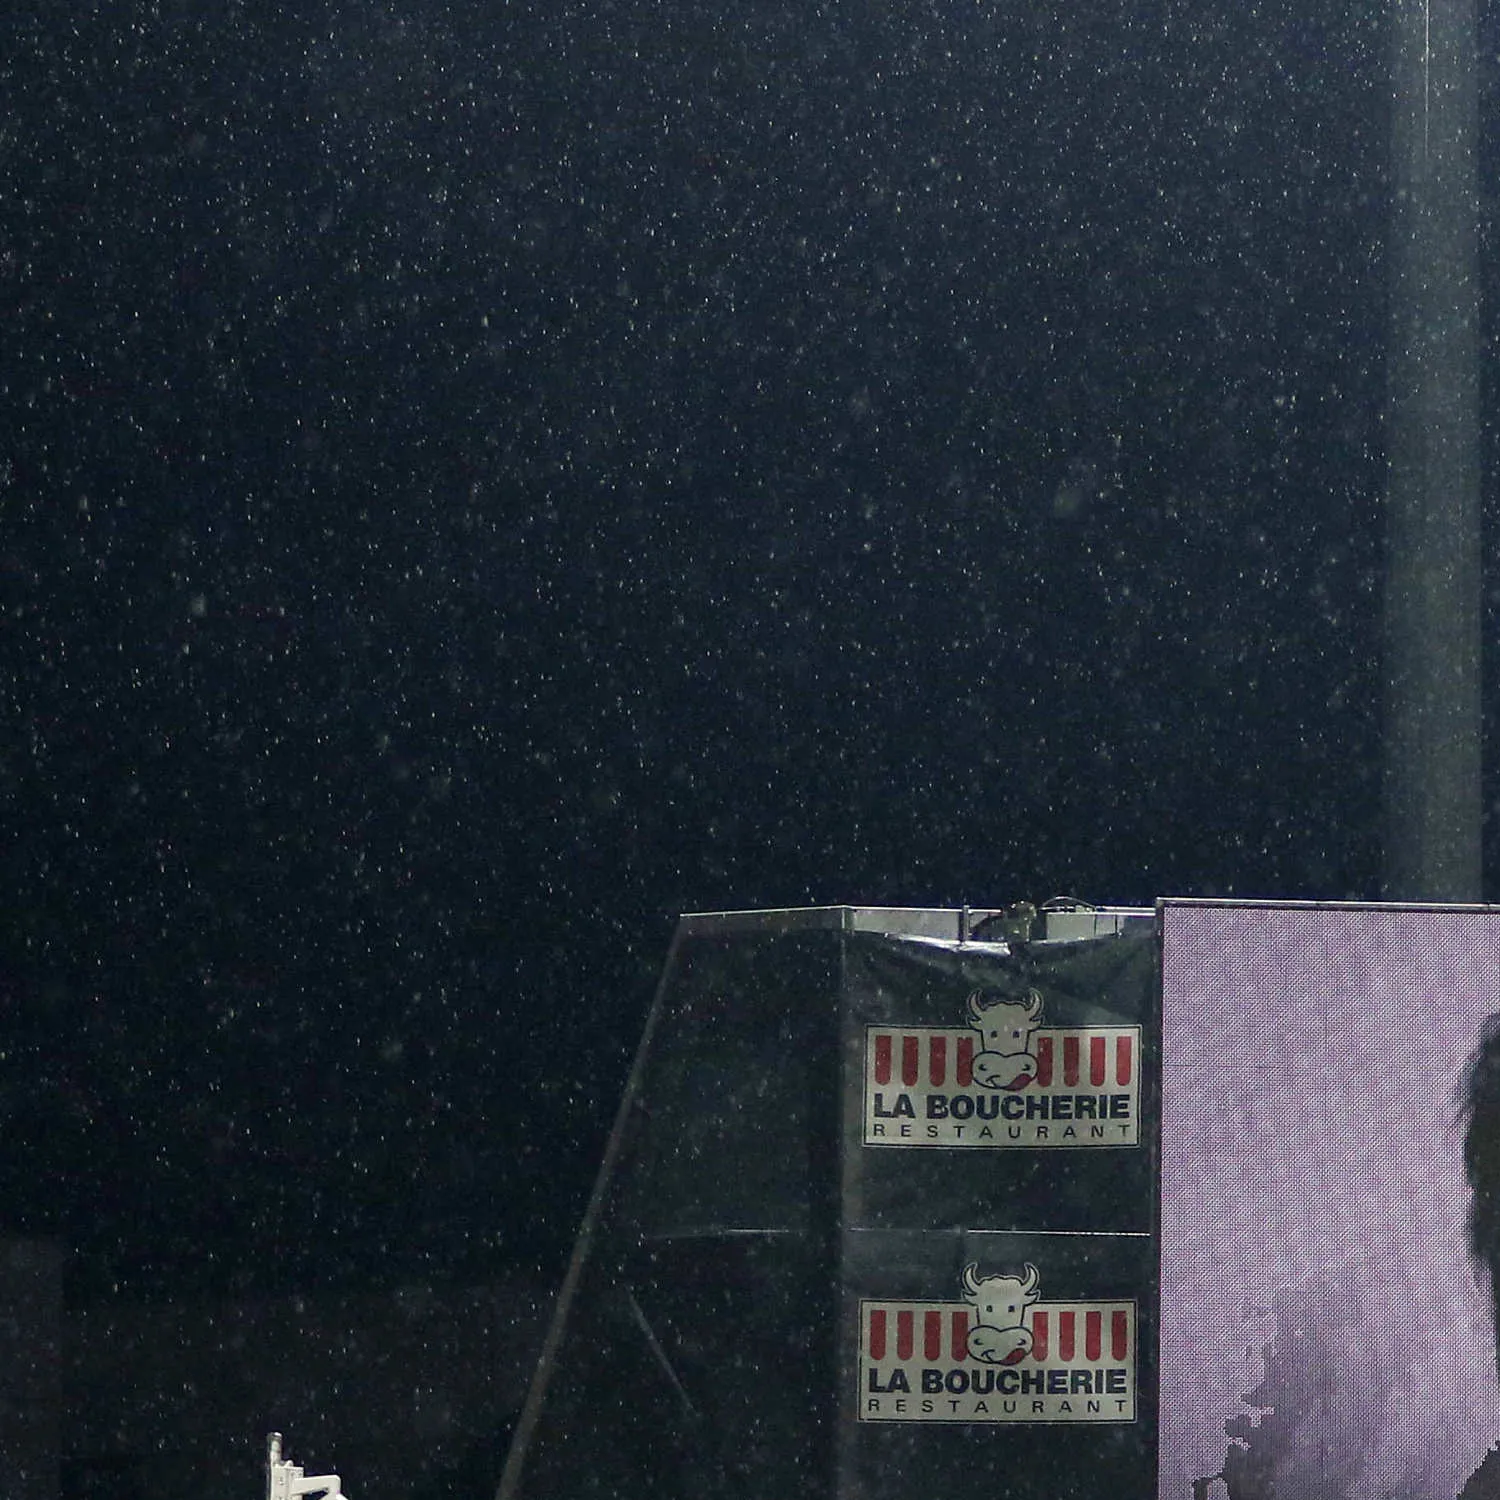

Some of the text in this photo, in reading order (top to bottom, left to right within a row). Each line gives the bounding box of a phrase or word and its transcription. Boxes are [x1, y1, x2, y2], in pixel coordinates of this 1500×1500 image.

[873, 1093, 1131, 1121] LA BOUCHERIE
[873, 1124, 1132, 1139] RESTAURANT
[868, 1368, 1127, 1395] LA BOUCHERIE
[868, 1399, 1126, 1414] RESTAURANT
